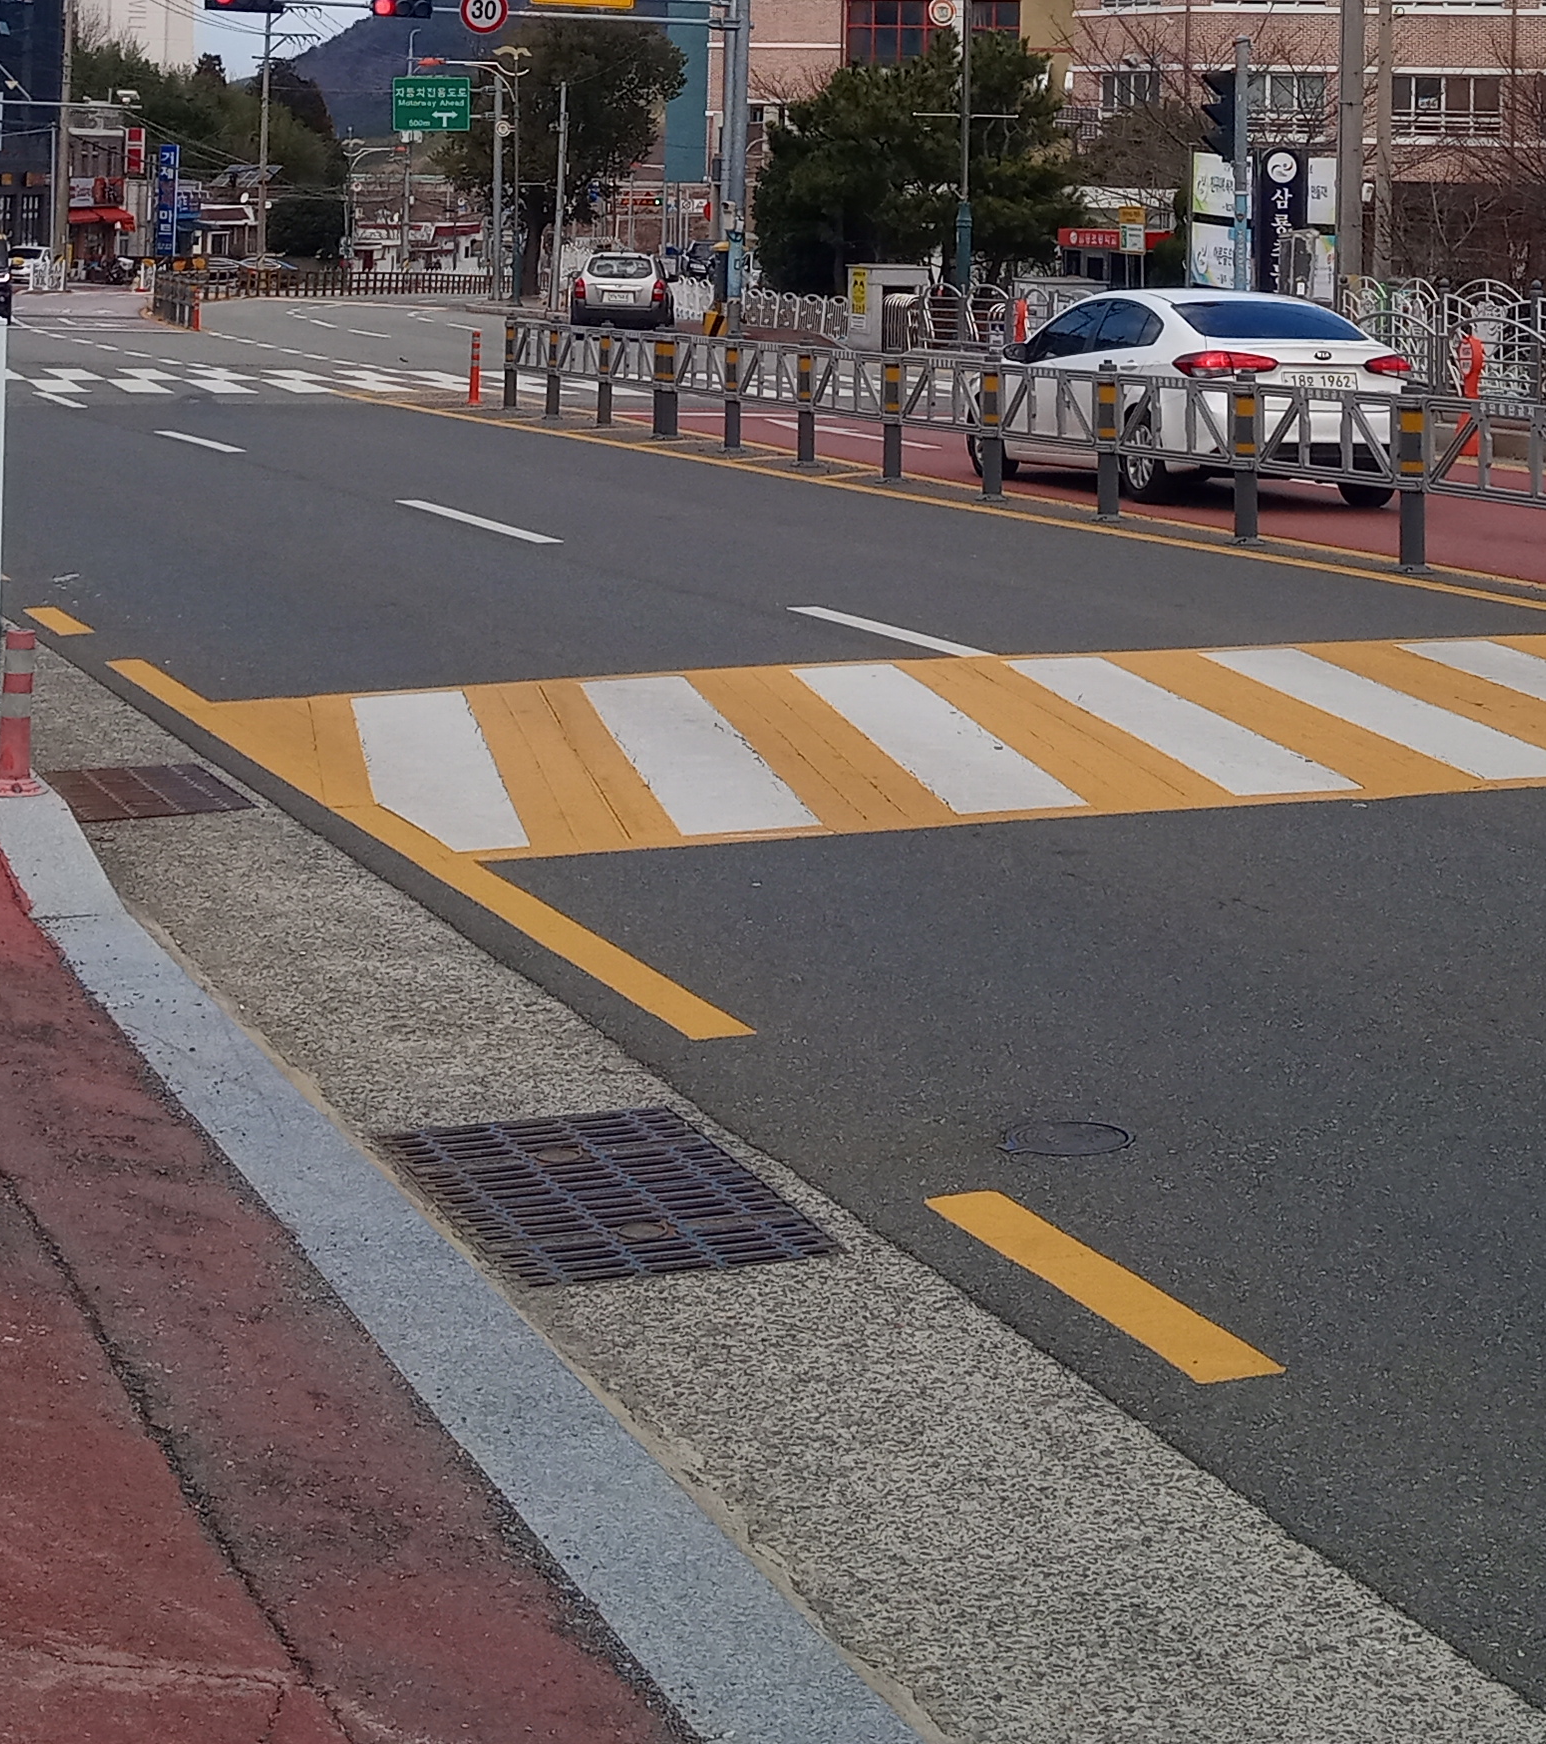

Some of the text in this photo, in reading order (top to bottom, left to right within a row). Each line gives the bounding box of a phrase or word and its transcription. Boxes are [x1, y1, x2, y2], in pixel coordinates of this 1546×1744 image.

[470, 0, 497, 20] 30
[395, 87, 468, 98] 자동차전용도로
[397, 99, 465, 108] Motorway Ahead
[1320, 375, 1351, 388] 1962
